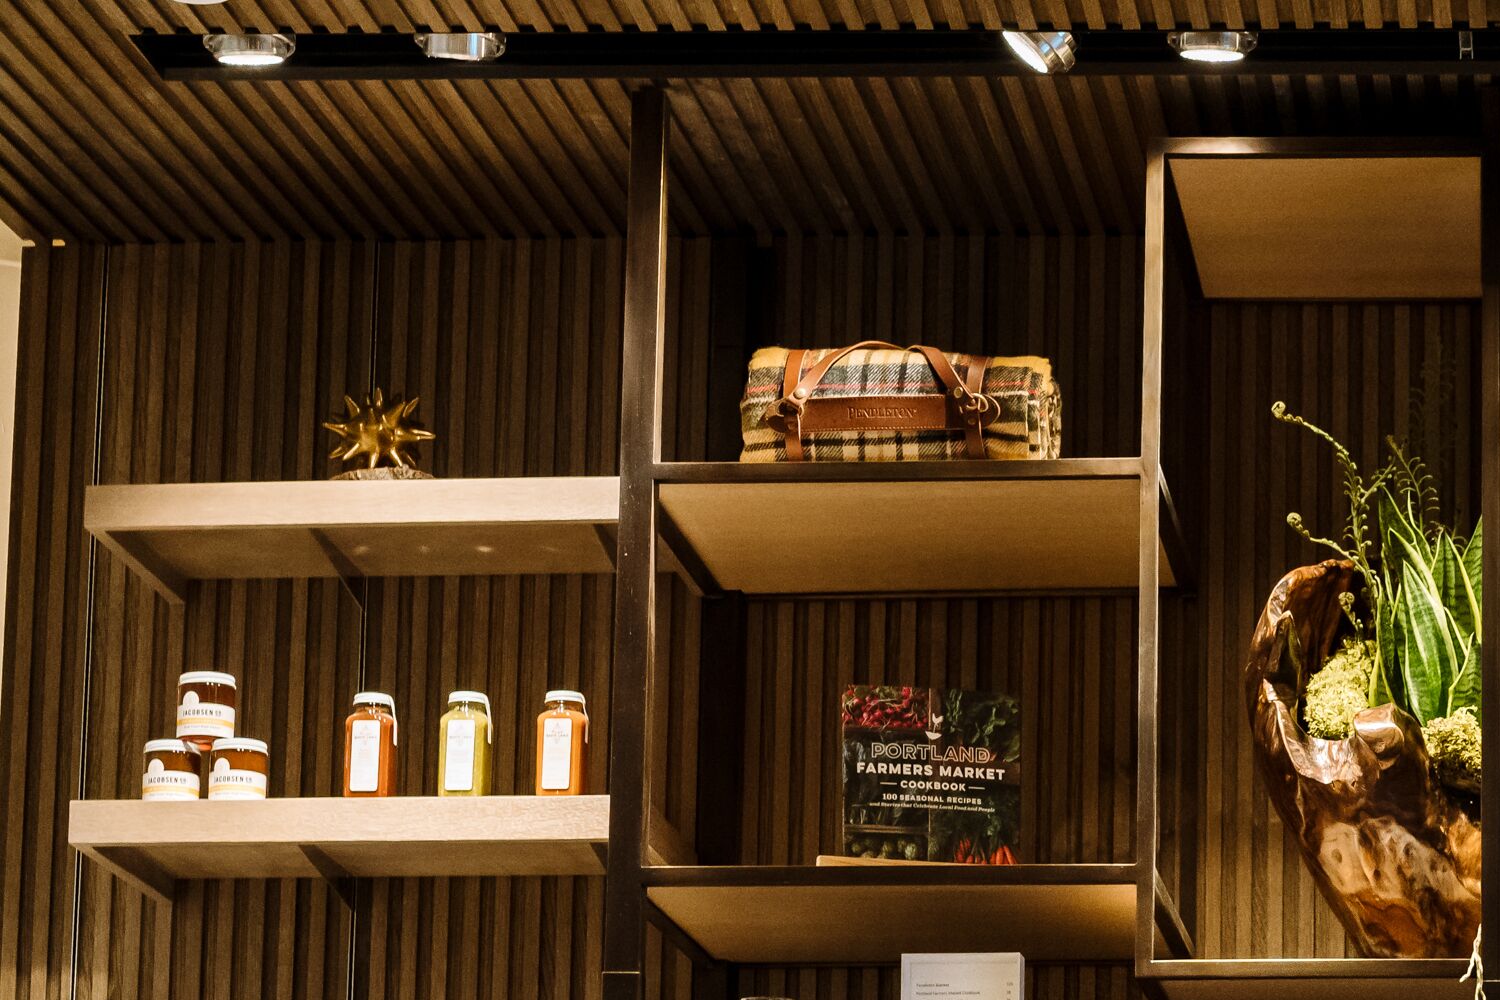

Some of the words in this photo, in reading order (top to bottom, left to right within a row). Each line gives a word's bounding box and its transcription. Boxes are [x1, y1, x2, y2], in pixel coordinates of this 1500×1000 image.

[847, 407, 914, 420] PENDLETON
[871, 742, 991, 764] PORTLAND
[856, 762, 933, 776] FARMERS
[939, 765, 1006, 781] MARKET
[900, 780, 966, 792] COOKBOOK
[899, 794, 944, 803] SEASONAL
[946, 796, 982, 805] RECIPES
